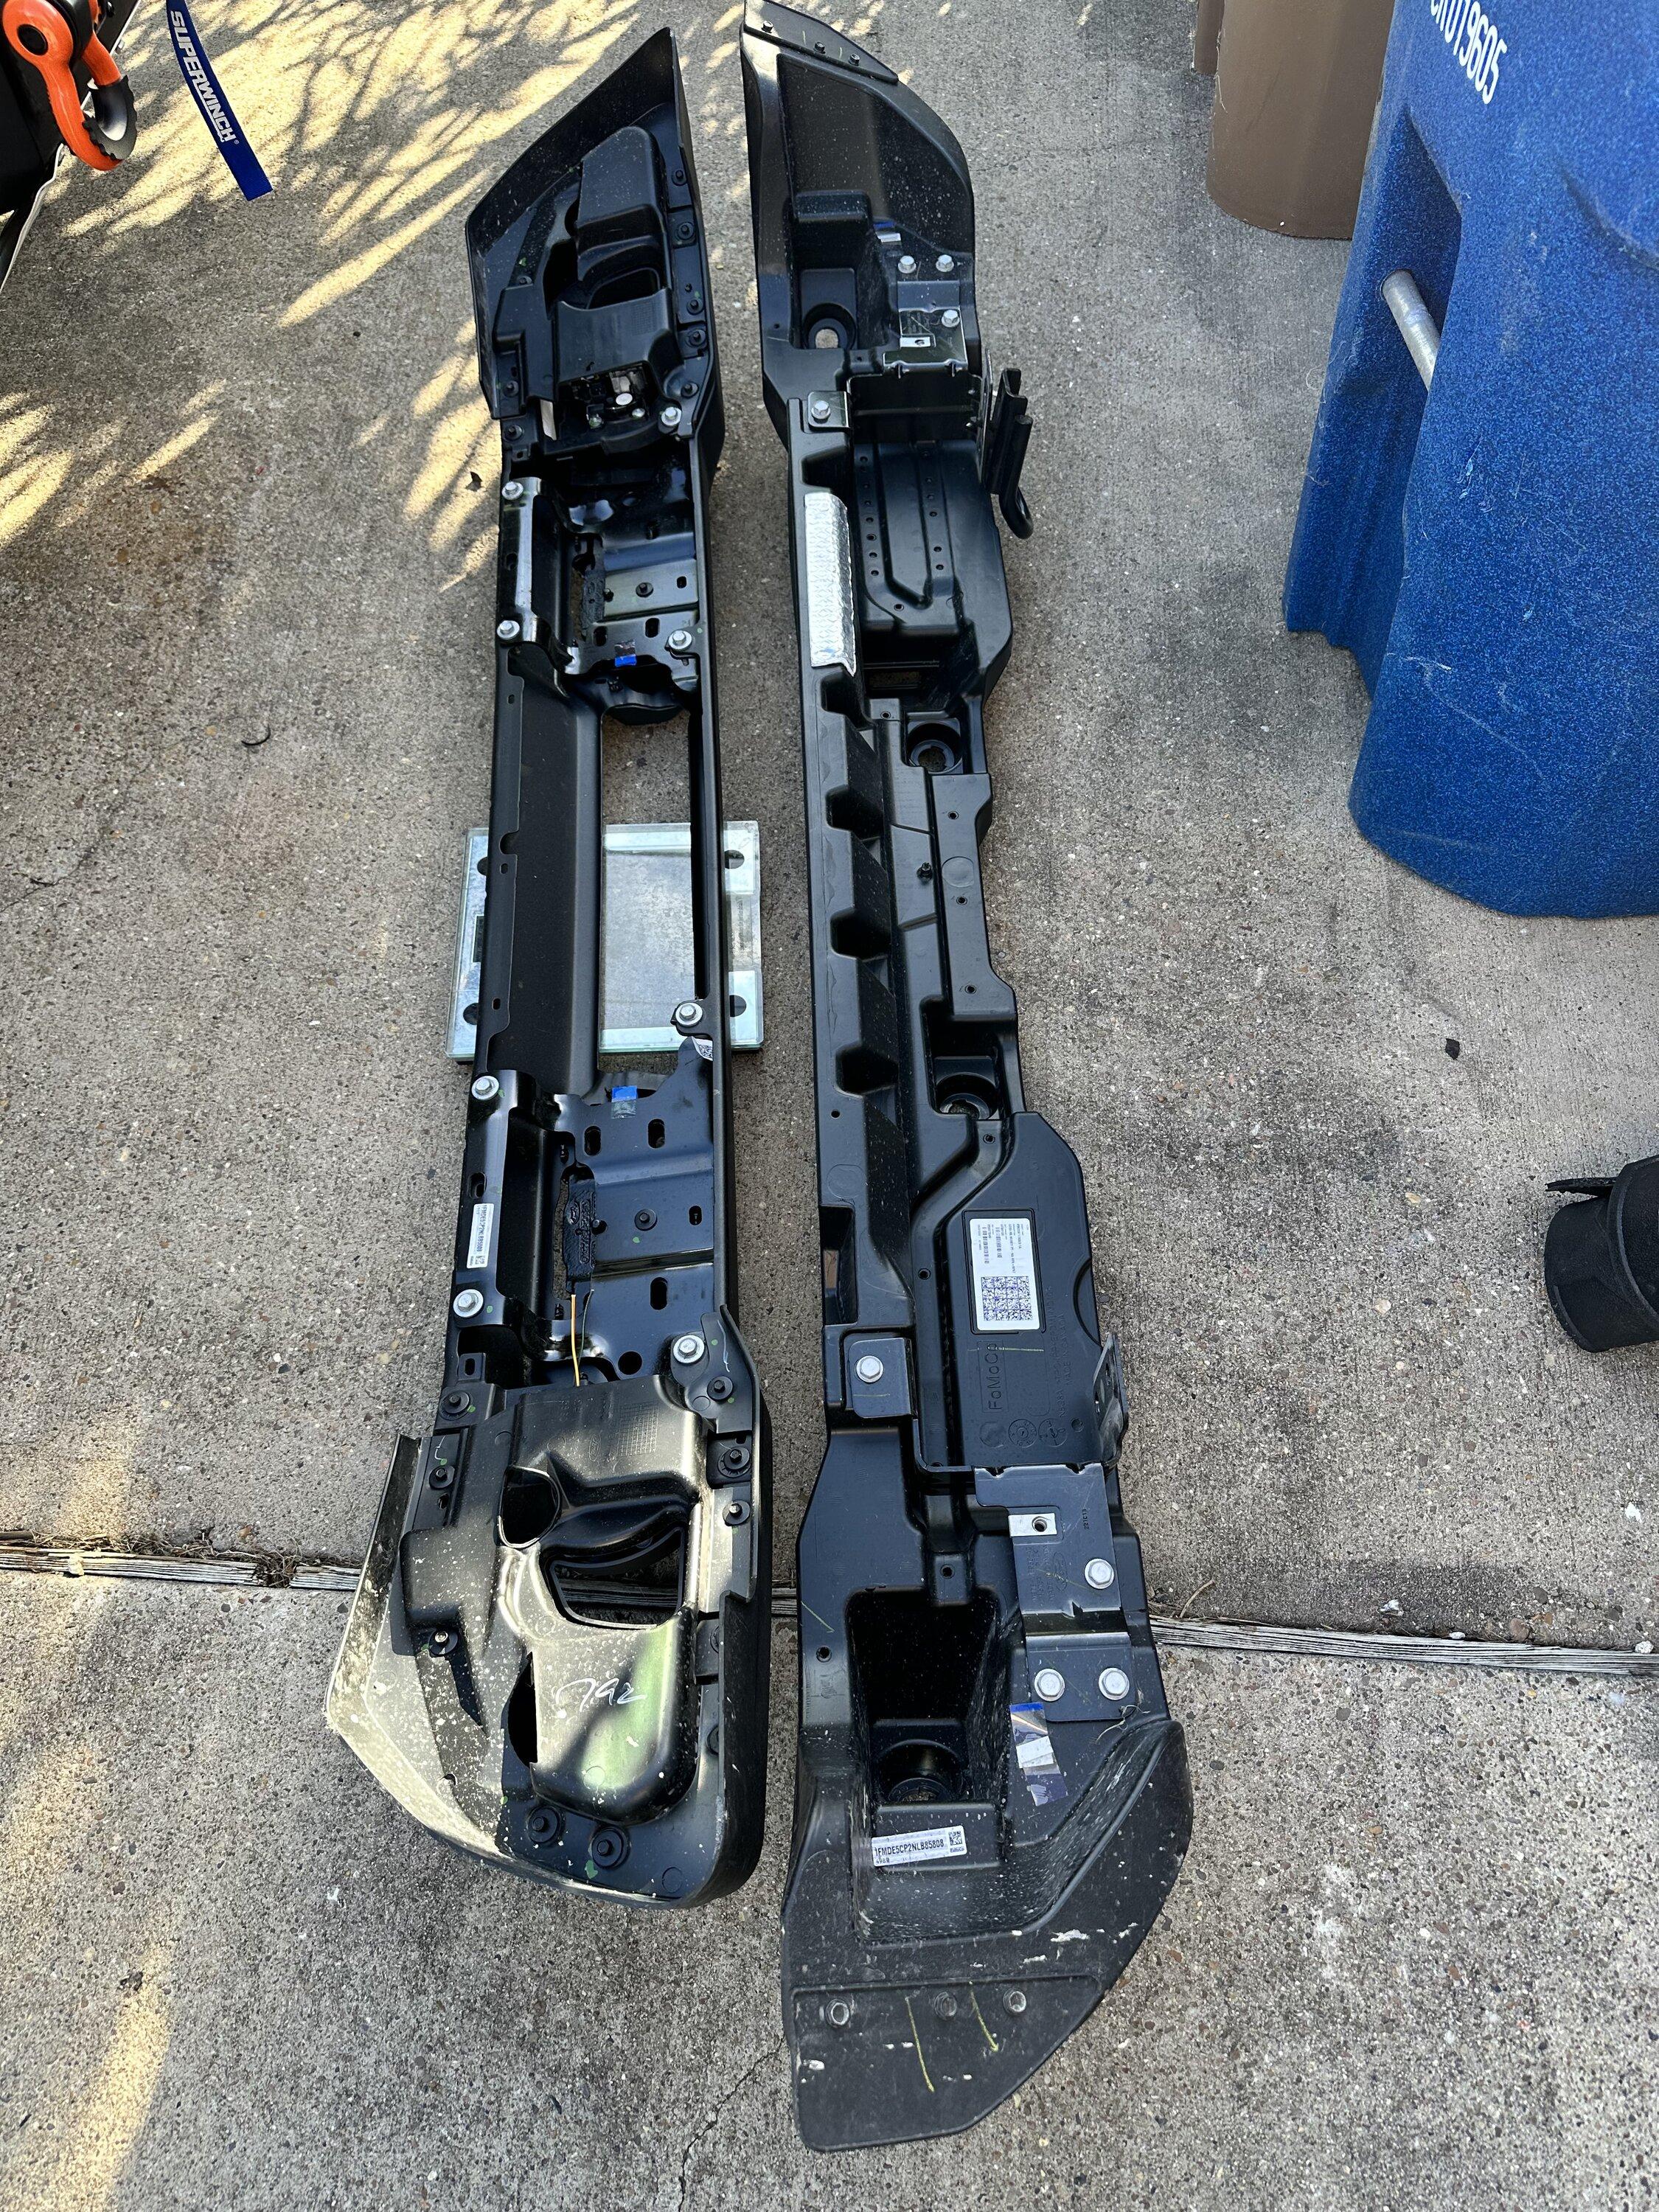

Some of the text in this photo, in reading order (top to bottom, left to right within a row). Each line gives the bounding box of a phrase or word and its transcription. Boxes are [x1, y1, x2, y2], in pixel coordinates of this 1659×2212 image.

[170, 10, 237, 142] SUPERWINCH
[1430, 0, 1507, 104] 019605
[984, 1343, 1003, 1409] FoMoCo
[874, 1838, 945, 1857] 1FMDE5CP2NLB85808
